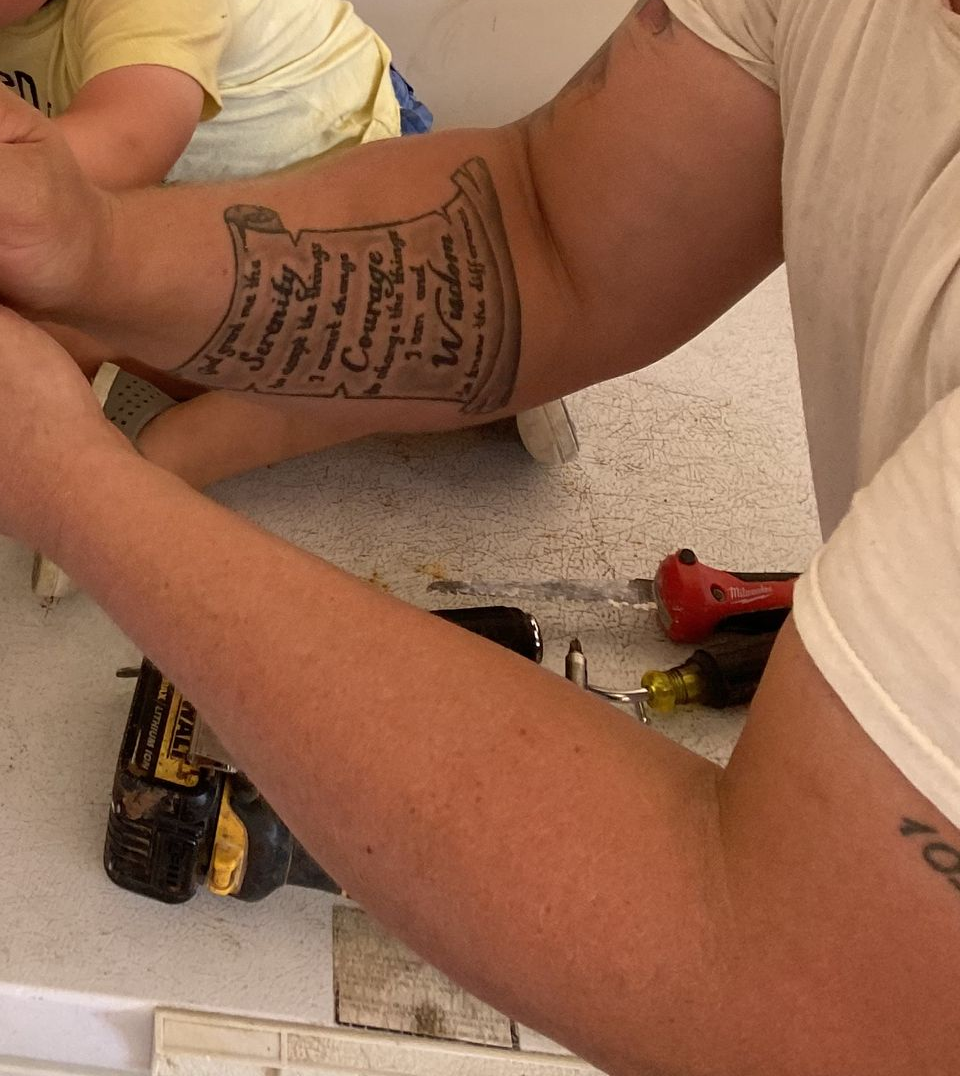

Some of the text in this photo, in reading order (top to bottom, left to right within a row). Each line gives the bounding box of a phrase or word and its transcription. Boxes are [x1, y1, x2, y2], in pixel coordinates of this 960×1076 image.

[239, 264, 306, 372] Serenity
[341, 250, 394, 372] Courage
[427, 233, 464, 367] Wisdom
[141, 749, 153, 770] ION
[147, 706, 163, 748] LITHIUM
